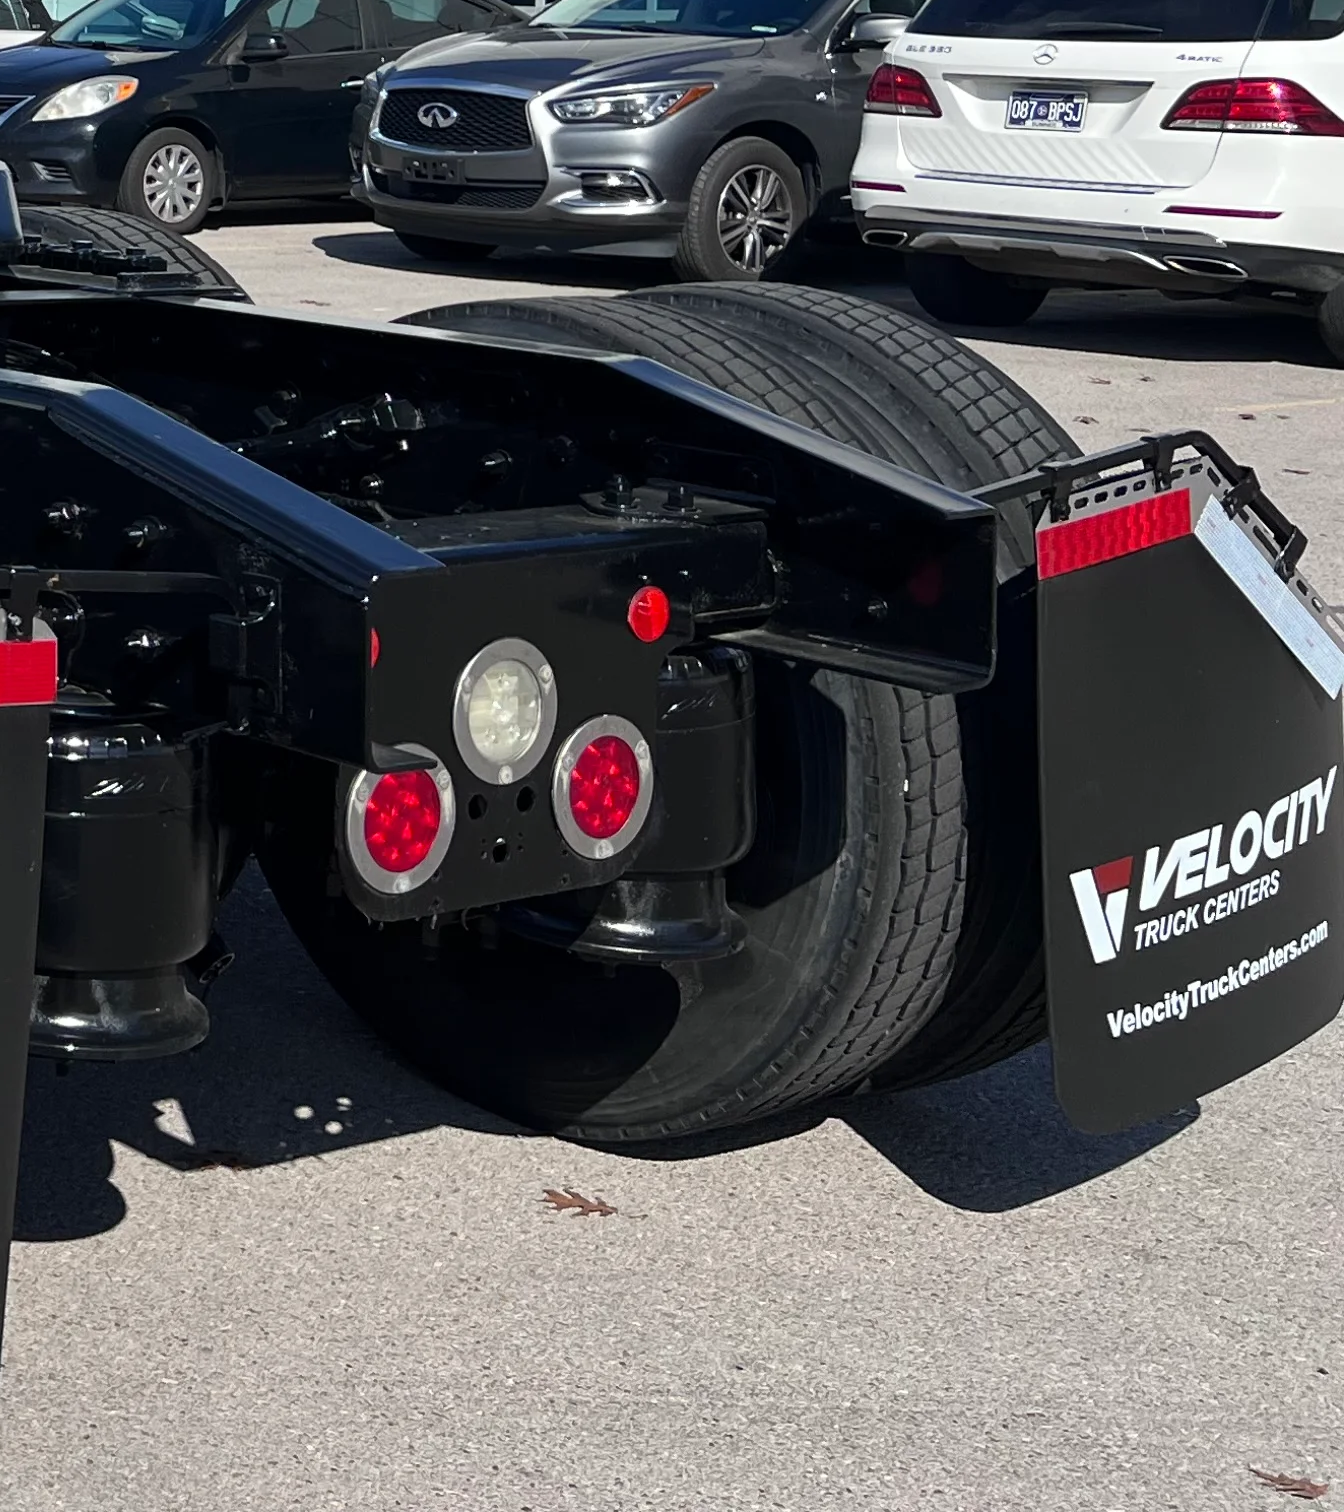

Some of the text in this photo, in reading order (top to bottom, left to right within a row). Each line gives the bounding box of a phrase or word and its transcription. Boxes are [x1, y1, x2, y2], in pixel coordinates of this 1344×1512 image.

[1011, 100, 1038, 120] 087
[1140, 766, 1338, 912] VELOCITY
[1133, 869, 1281, 951] TRUCK CENTERS
[1107, 920, 1329, 1038] VelocityTruckCenters.com
